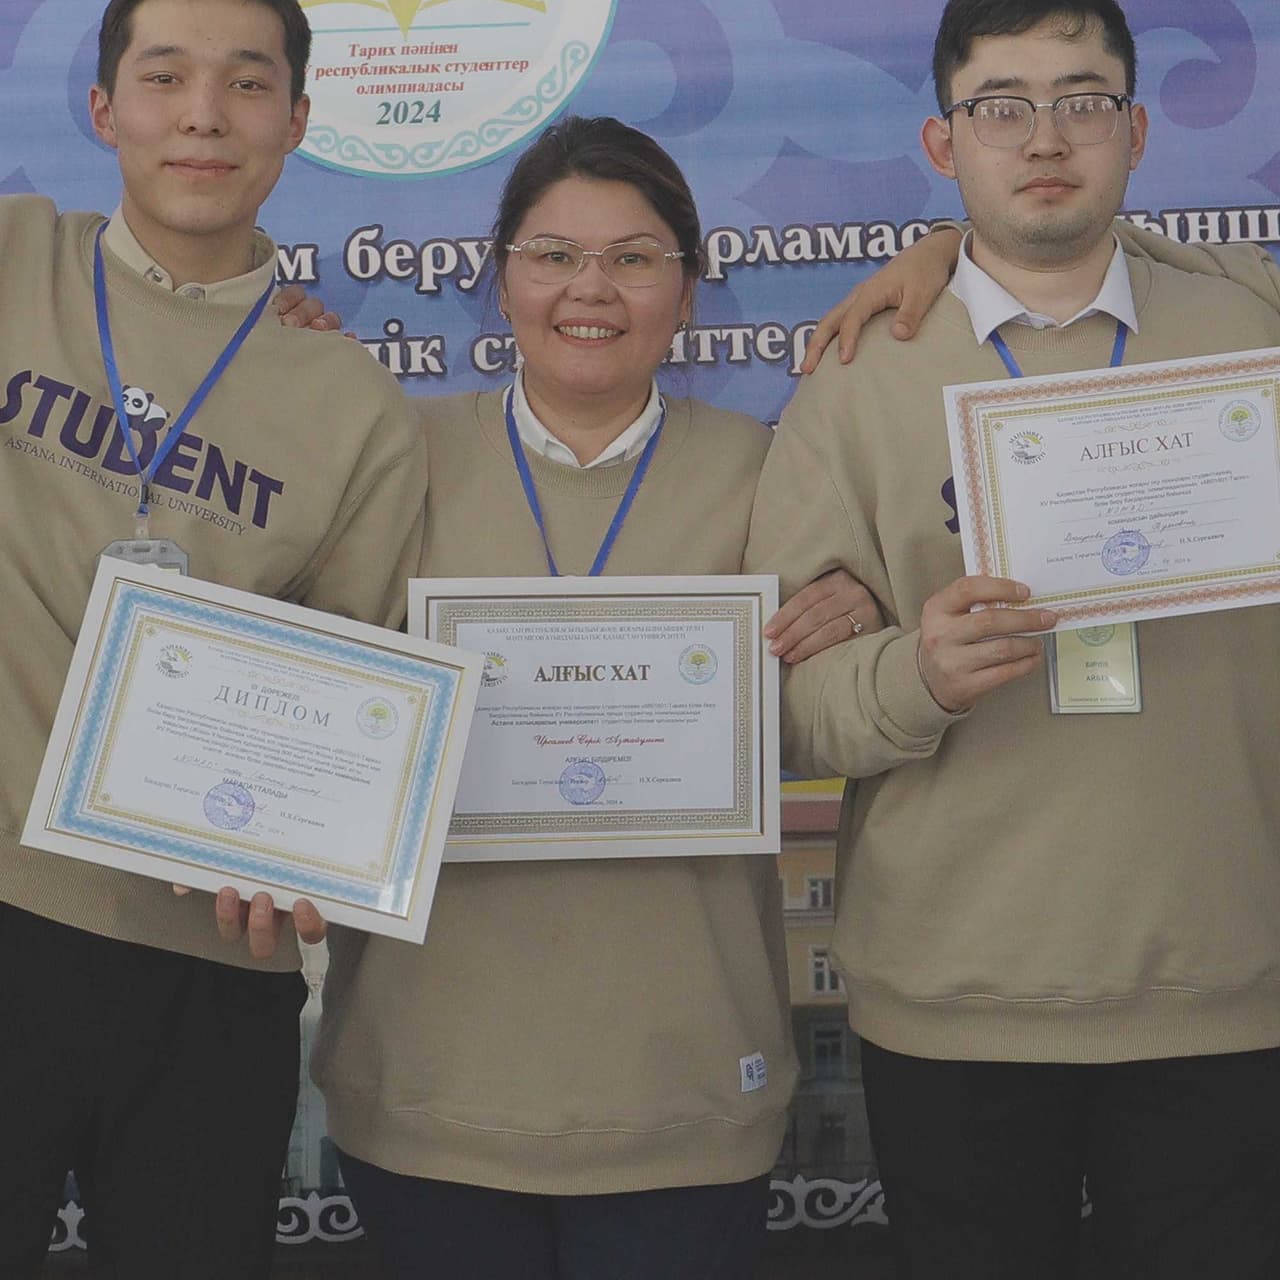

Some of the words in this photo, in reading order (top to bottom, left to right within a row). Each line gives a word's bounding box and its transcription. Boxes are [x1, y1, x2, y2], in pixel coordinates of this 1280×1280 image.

[348, 43, 396, 60] Тарих
[445, 60, 529, 77] студенттер
[356, 83, 464, 96] олимпиадасы
[376, 99, 442, 125] 2024
[1080, 437, 1150, 463] АЛҒЫС
[1155, 431, 1194, 452] ХАТ
[5, 436, 57, 466] ASTANA
[59, 457, 165, 508] INTERNATIOAL
[168, 496, 246, 537] UNIVERSITY
[533, 664, 607, 683] АЛҒЫС
[611, 663, 651, 681] ХАТ
[214, 684, 333, 728] ДИПЛОМ
